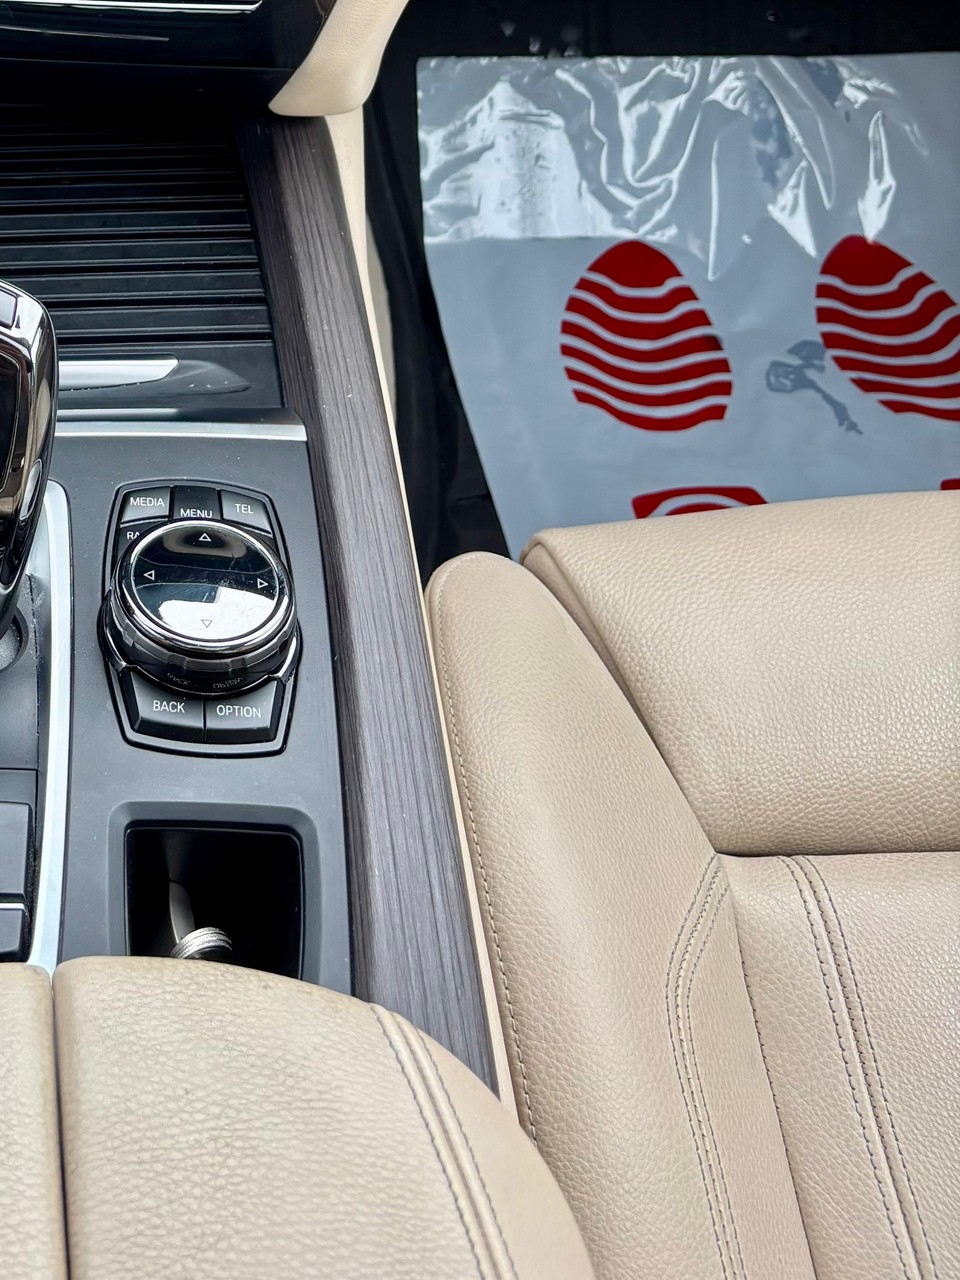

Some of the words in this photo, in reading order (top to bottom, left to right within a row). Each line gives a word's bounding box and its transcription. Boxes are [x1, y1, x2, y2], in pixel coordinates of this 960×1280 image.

[130, 497, 165, 507] MEDIA
[180, 508, 213, 519] MENU
[235, 503, 254, 515] TEL
[153, 700, 185, 713] BACK
[216, 705, 261, 719] OPTION
